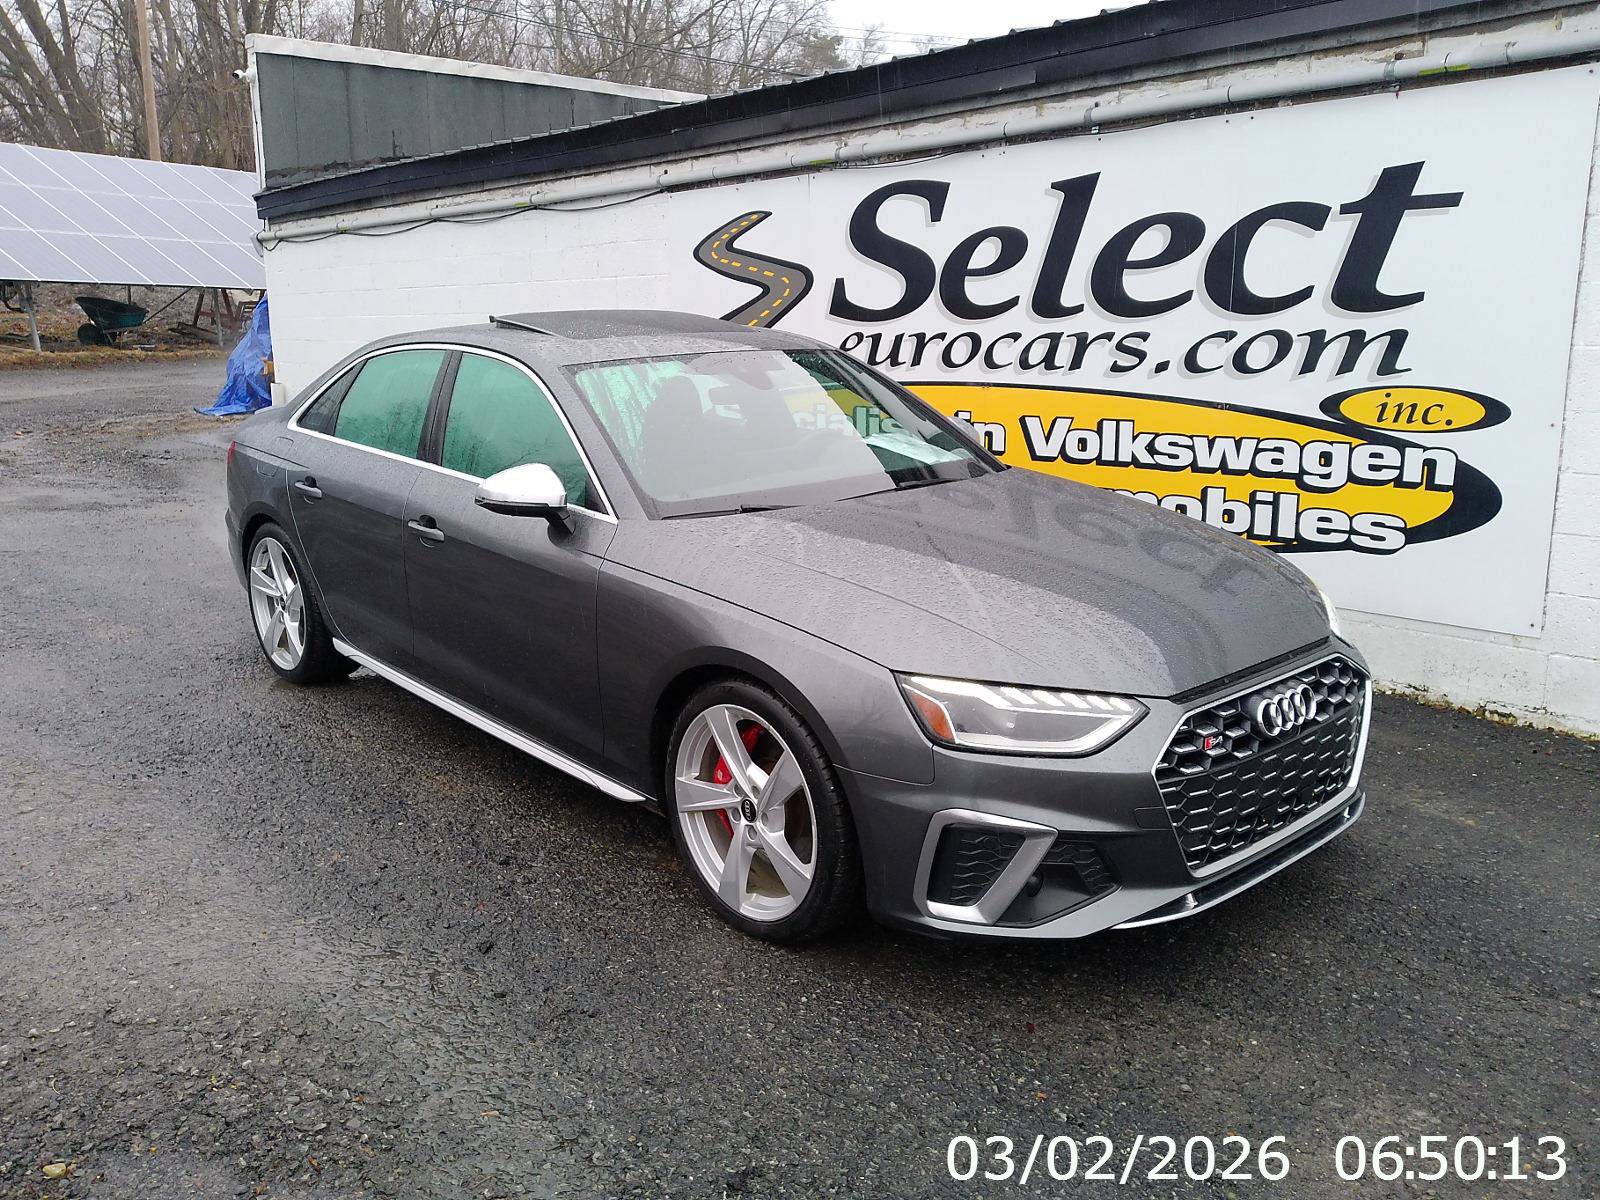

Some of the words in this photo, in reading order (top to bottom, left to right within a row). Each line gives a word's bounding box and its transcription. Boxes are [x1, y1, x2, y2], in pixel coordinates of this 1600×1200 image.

[828, 160, 1464, 323] Select
[839, 328, 1412, 378] eurocars.com
[1375, 392, 1454, 426] inc.
[1019, 415, 1458, 491] Volkswagen
[1100, 485, 1407, 553] obiles
